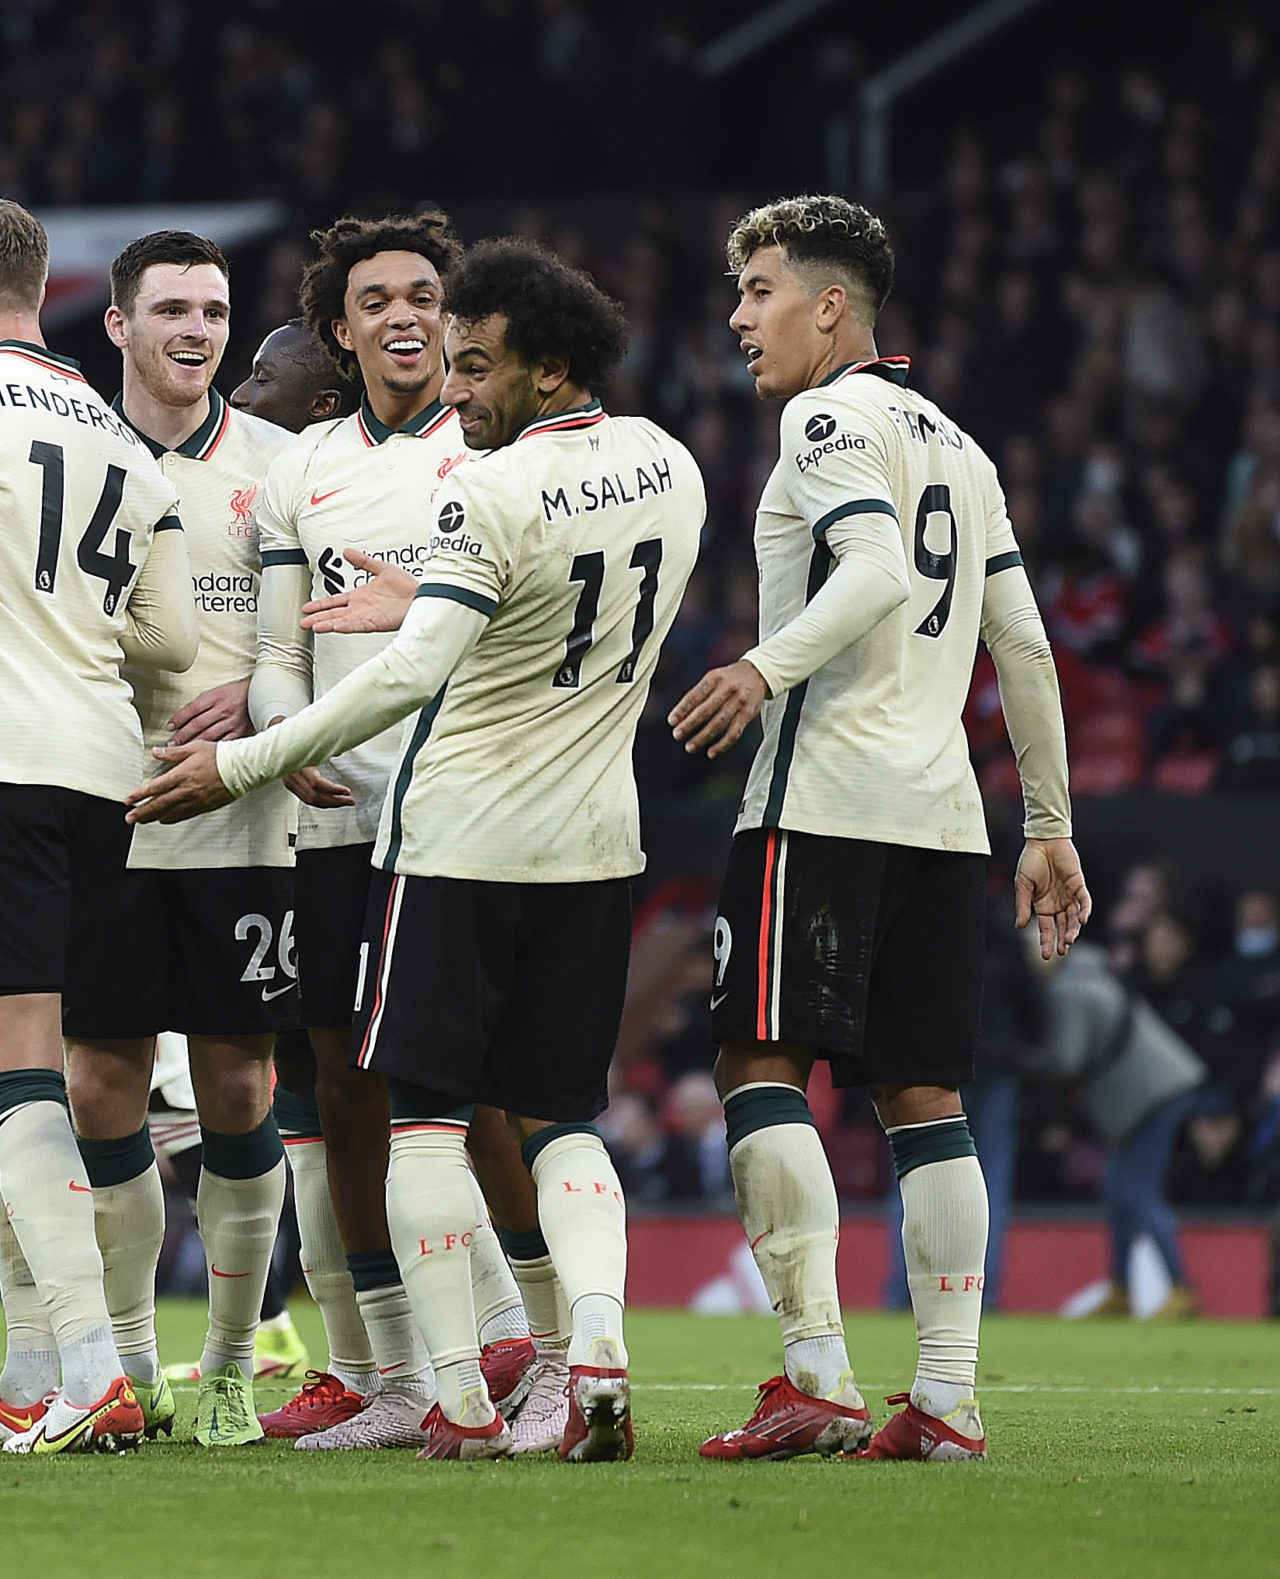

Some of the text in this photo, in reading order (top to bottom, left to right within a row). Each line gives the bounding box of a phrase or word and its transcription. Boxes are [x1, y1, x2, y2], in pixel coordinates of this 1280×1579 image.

[795, 433, 866, 474] Expedia
[29, 439, 138, 617] 14
[228, 525, 254, 538] LFC
[913, 483, 958, 639] 9
[552, 537, 663, 688] 11
[234, 909, 297, 982] 26
[714, 915, 732, 987] 9
[419, 1231, 473, 1256] LFC
